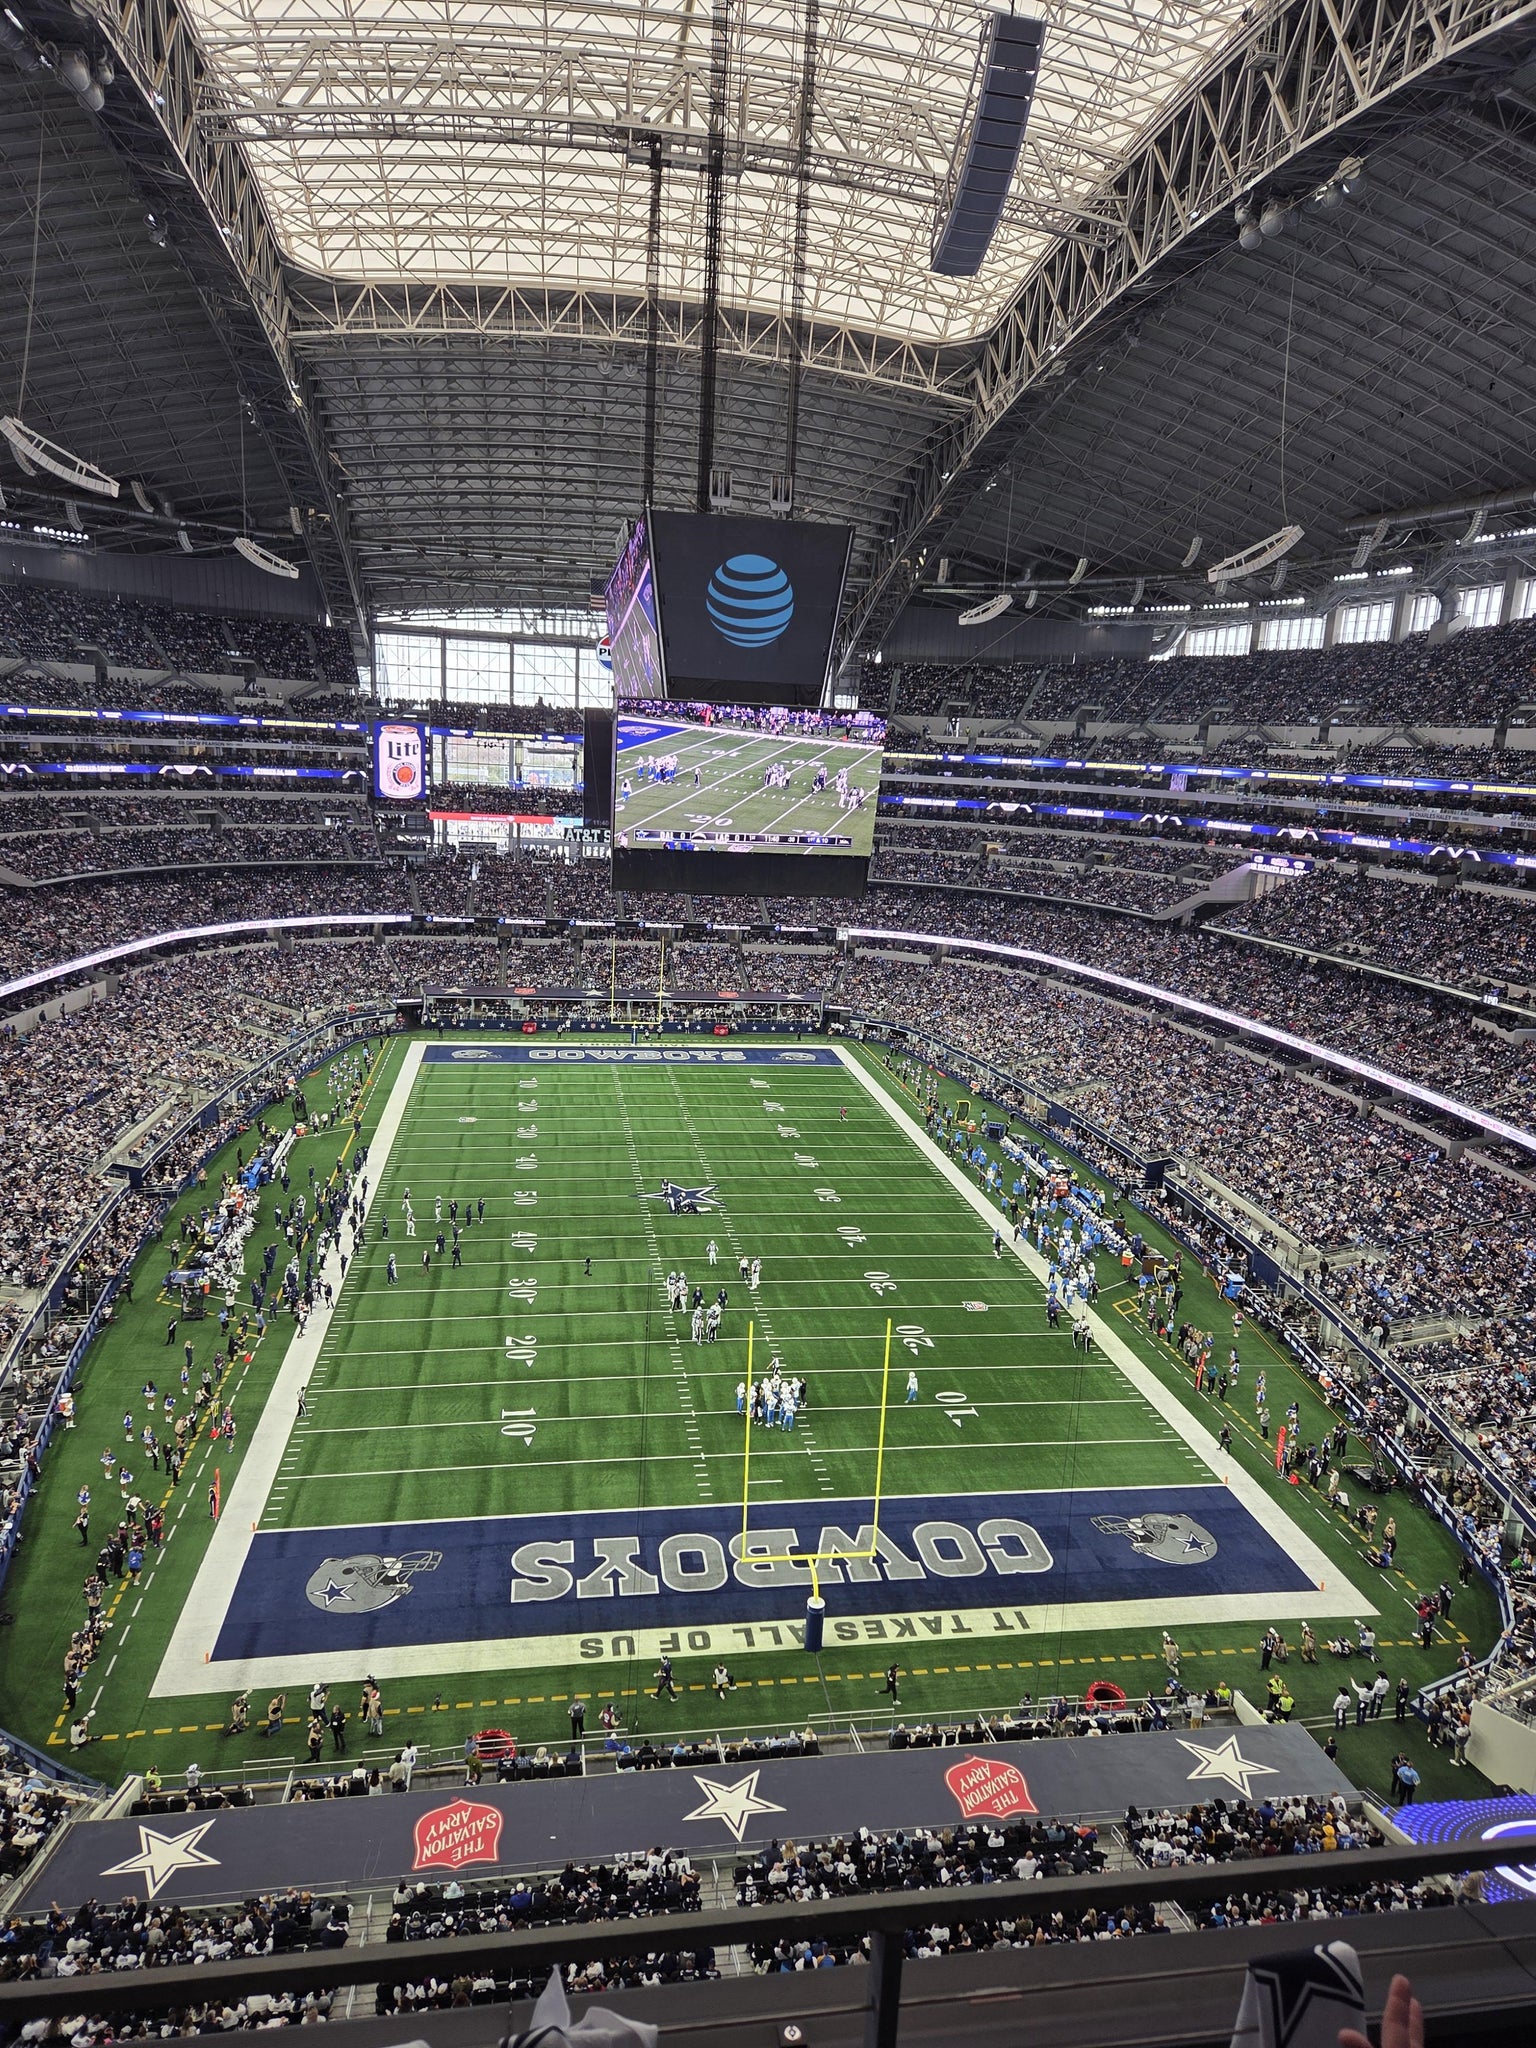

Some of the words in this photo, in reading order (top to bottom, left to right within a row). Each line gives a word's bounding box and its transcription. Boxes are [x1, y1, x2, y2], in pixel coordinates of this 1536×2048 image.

[388, 741, 419, 760] Lite
[565, 828, 600, 843] AT&T
[660, 831, 674, 840] DAL
[680, 832, 685, 840] 0
[715, 833, 730, 842] LAC
[764, 835, 779, 843] 11:40
[529, 1049, 747, 1061] COWBOYS
[518, 1101, 538, 1112] 20
[517, 1126, 538, 1139] 30
[777, 1126, 800, 1138] 30
[515, 1156, 538, 1170] 40
[794, 1155, 819, 1168] 40
[513, 1190, 538, 1206] 50
[813, 1188, 841, 1202] 50
[511, 1230, 538, 1248] 40
[836, 1226, 867, 1243] 40
[509, 1277, 538, 1299] 30
[864, 1271, 897, 1292] 30
[896, 1325, 935, 1348] 20
[505, 1335, 538, 1360] 20
[935, 1391, 979, 1418] 10
[501, 1407, 537, 1436] 10
[511, 1518, 1054, 1603] COWBOYS
[834, 1614, 973, 1641] TAKES
[993, 1610, 1031, 1631] IT
[659, 1630, 711, 1654] OF
[732, 1624, 806, 1648] ALL
[580, 1635, 636, 1659] US
[960, 1763, 991, 1793] ARMY
[963, 1768, 1019, 1811] SALVATION
[991, 1790, 1019, 1812] THE
[426, 1806, 472, 1842] ARMY
[421, 1813, 497, 1862] SALVATION
[450, 1837, 485, 1862] THE
[1160, 1850, 1170, 1860] 43
[745, 1890, 758, 1902] 22
